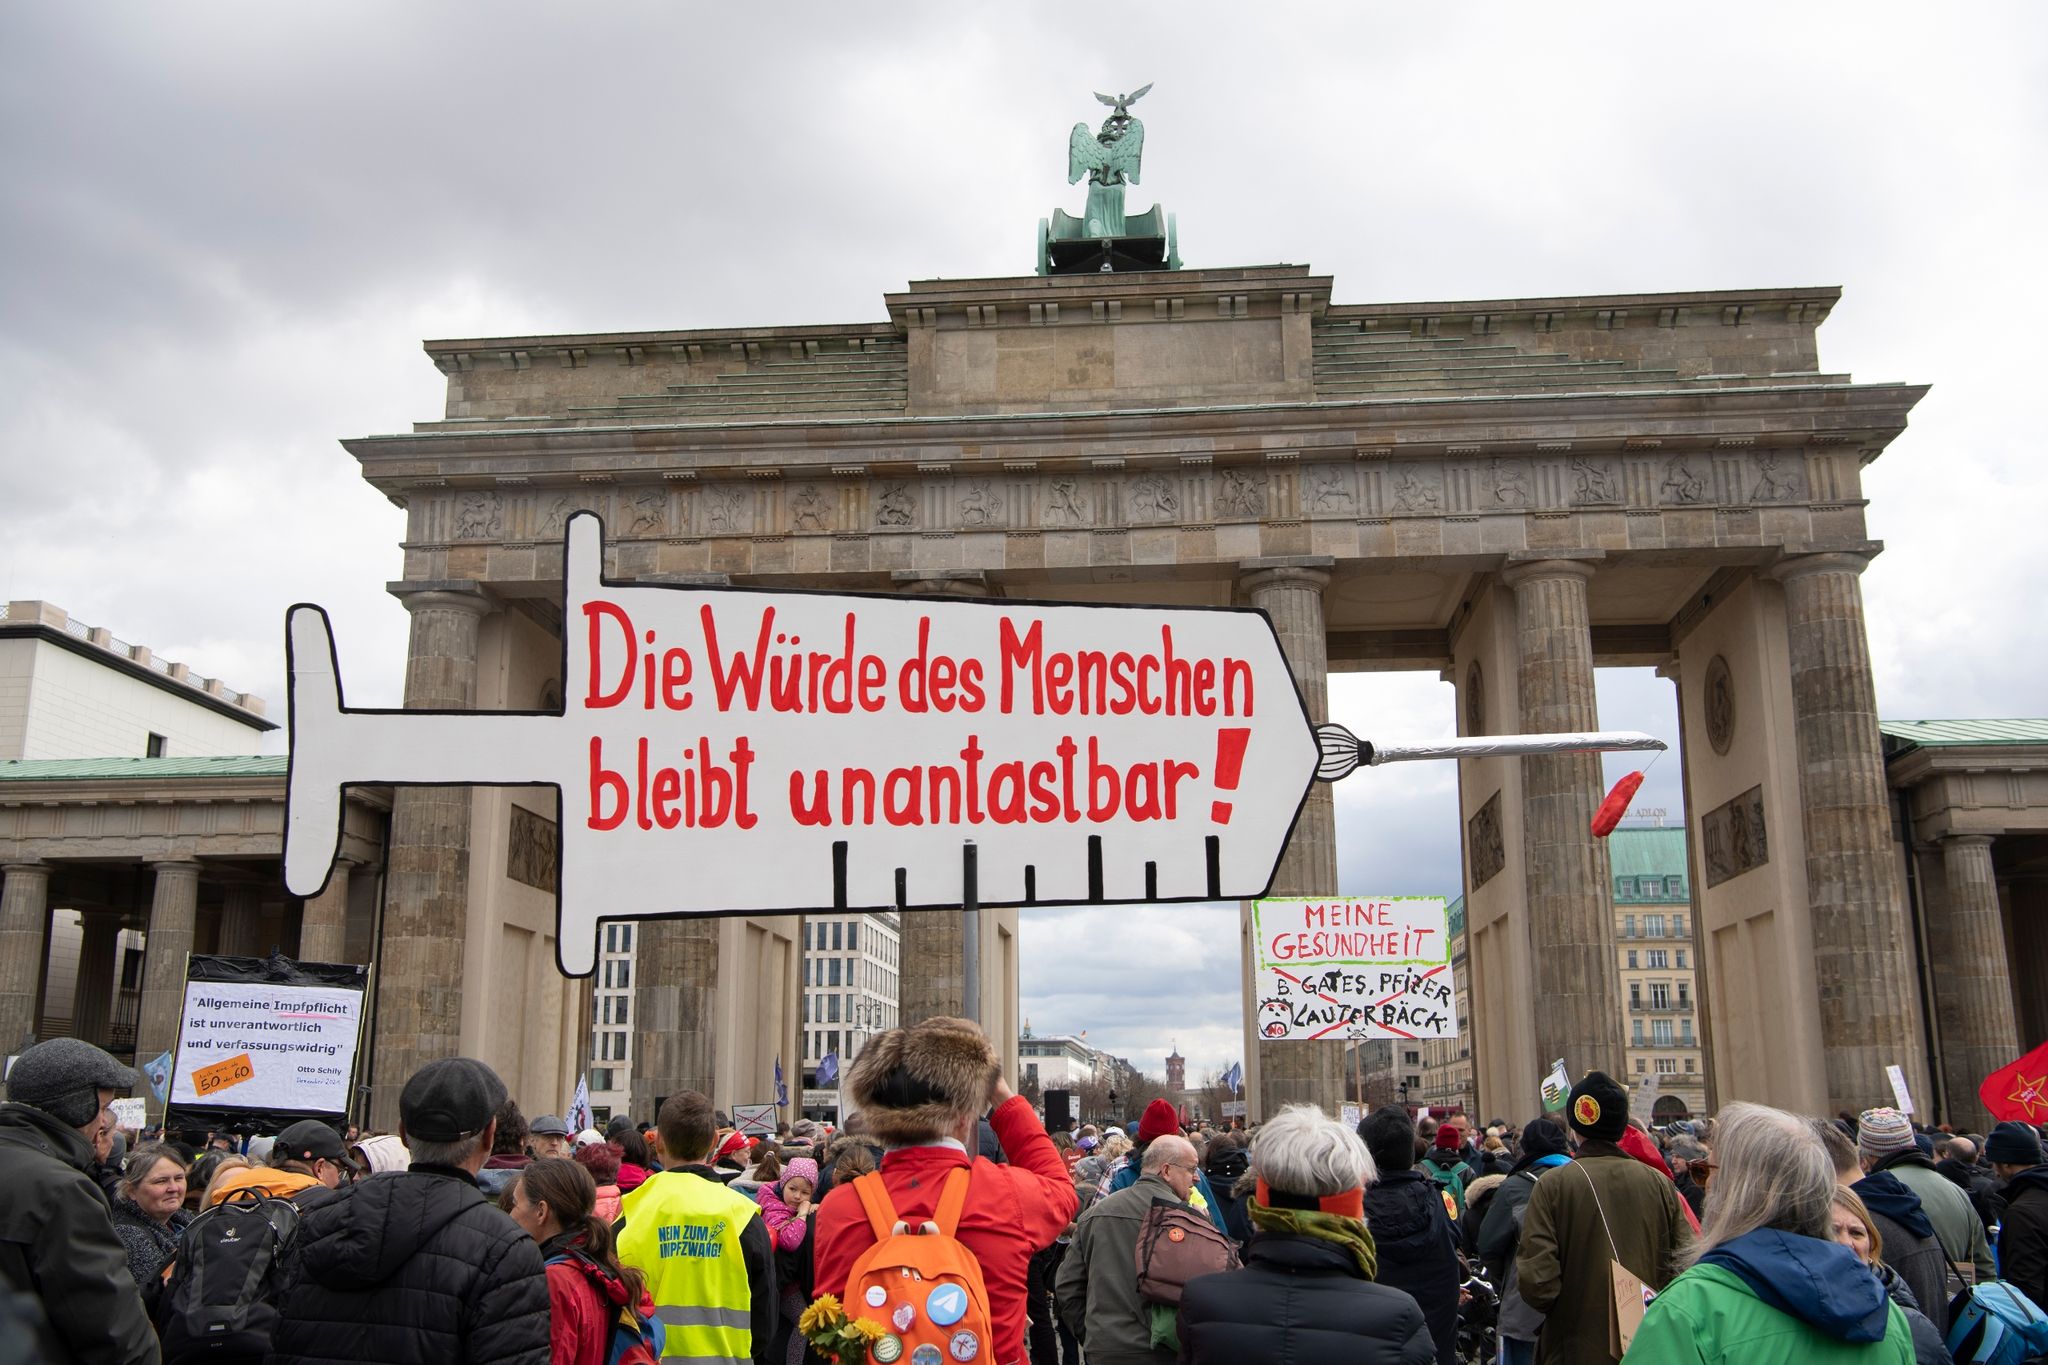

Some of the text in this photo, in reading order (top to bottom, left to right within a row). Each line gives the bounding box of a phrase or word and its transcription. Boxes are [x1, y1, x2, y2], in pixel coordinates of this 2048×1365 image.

[582, 600, 1253, 717] Die Würde des Menschen
[587, 728, 1251, 831] bleibt unantastbar!
[1305, 903, 1393, 928] MEINE
[193, 997, 348, 1014] "Allgemeine Impfpflicht
[190, 1018, 322, 1033] ist unverantwortlich
[1267, 1023, 1284, 1035] NO
[187, 1039, 343, 1056] und verfassungswidrig"
[201, 1076, 220, 1091] 50
[235, 1066, 249, 1079] 60
[297, 1066, 342, 1076] Otto Schily
[658, 1225, 708, 1242] NEIN ZUM
[660, 1241, 722, 1258] IMPFZWANG!
